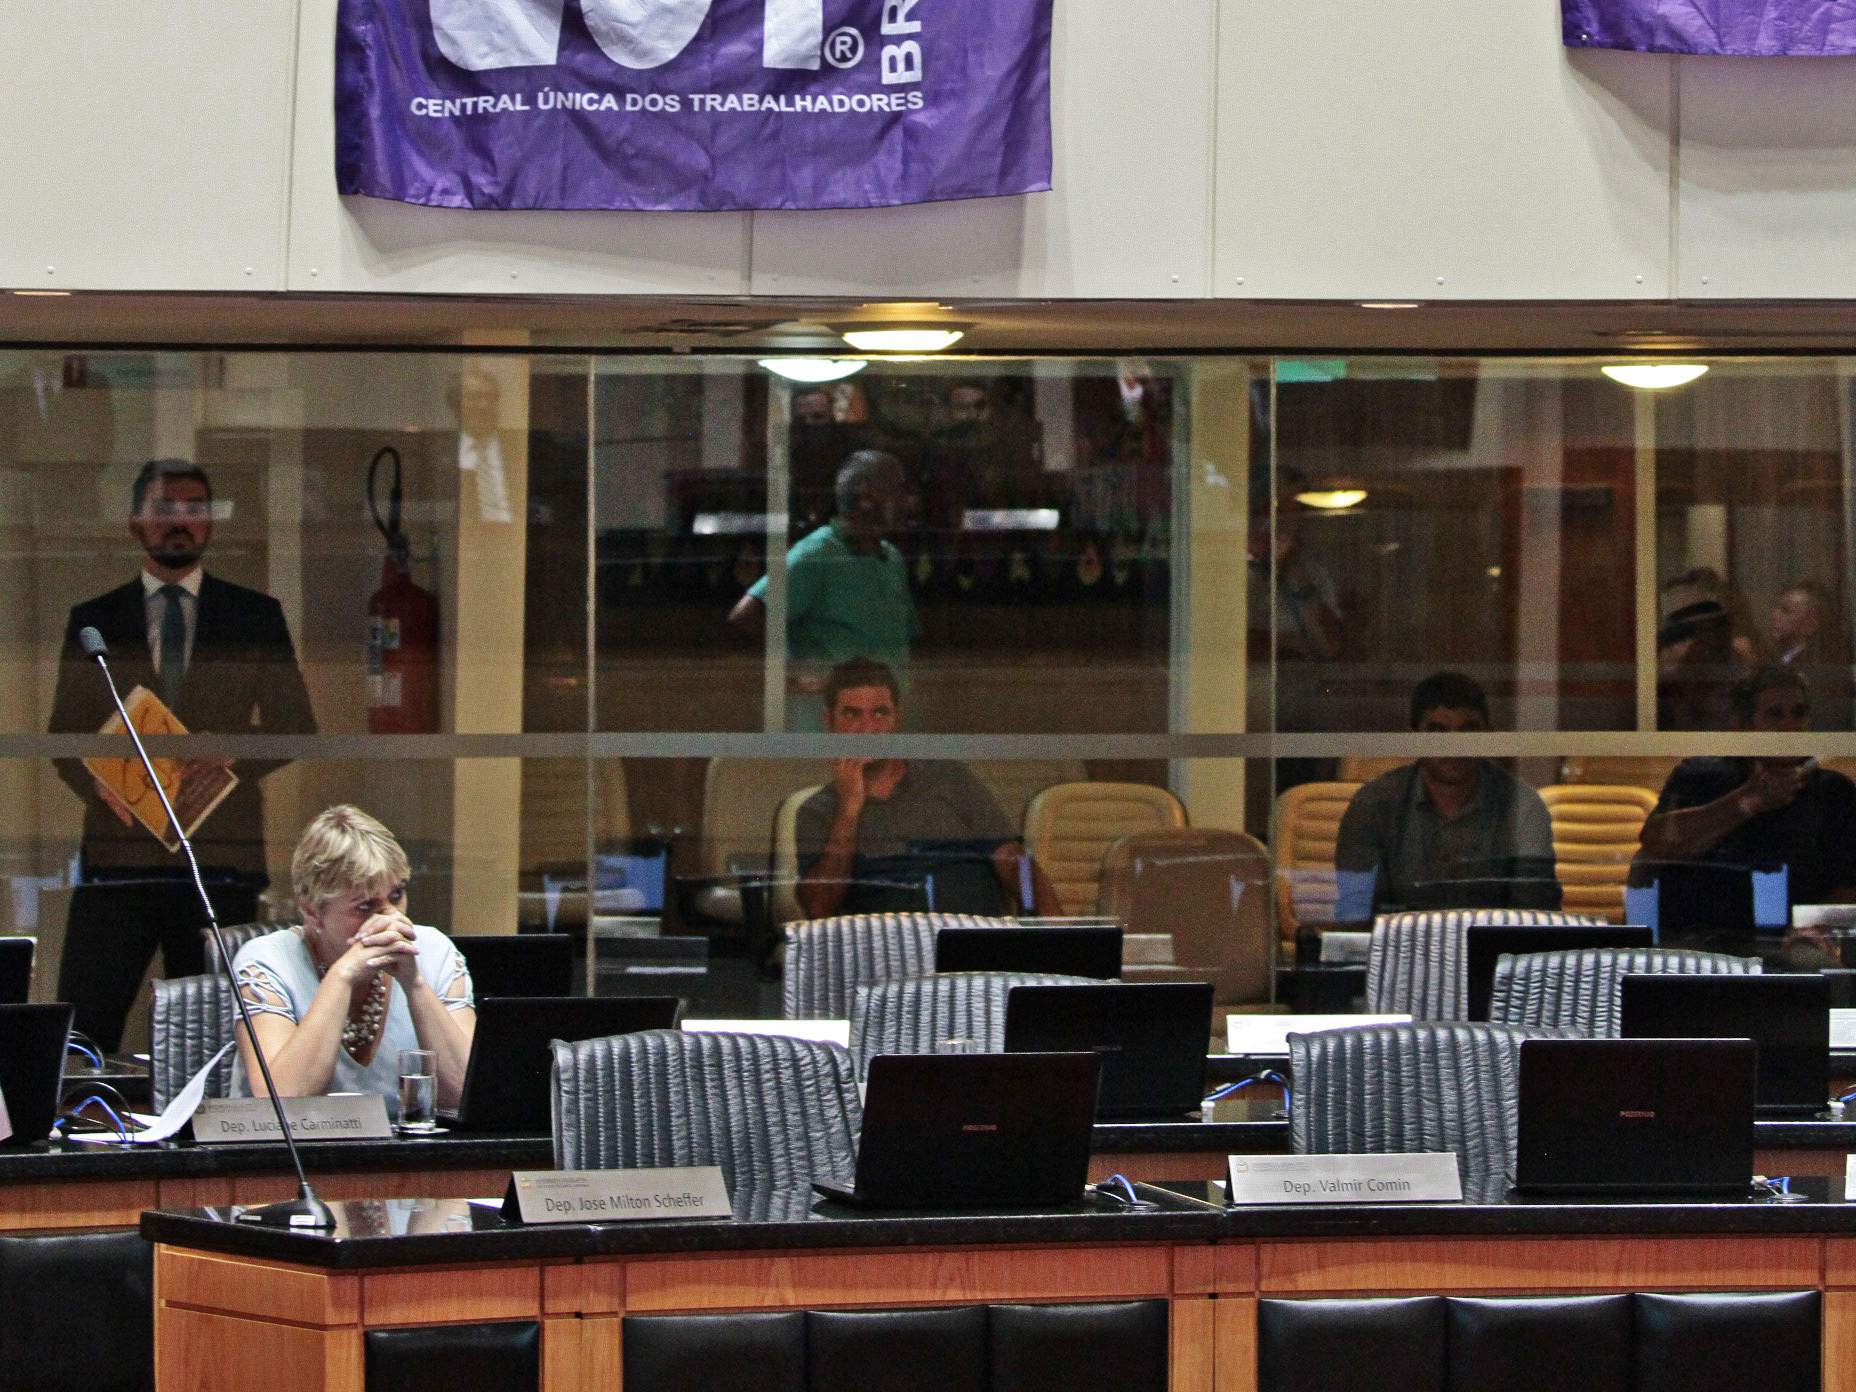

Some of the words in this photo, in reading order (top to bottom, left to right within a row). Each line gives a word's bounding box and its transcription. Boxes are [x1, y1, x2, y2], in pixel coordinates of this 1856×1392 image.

[410, 93, 531, 119] CENTRAL
[537, 86, 620, 113] ÚNICA
[625, 92, 682, 113] DOS
[688, 90, 925, 115] TRABALHADORES
[221, 1119, 249, 1135] Dep.
[1283, 1180, 1316, 1196] Dep.
[1319, 1178, 1363, 1193] Valmir
[1366, 1178, 1411, 1192] Comin
[545, 1197, 575, 1214] Dep.
[609, 1195, 651, 1211] Milton
[655, 1192, 705, 1209] Scheffer
